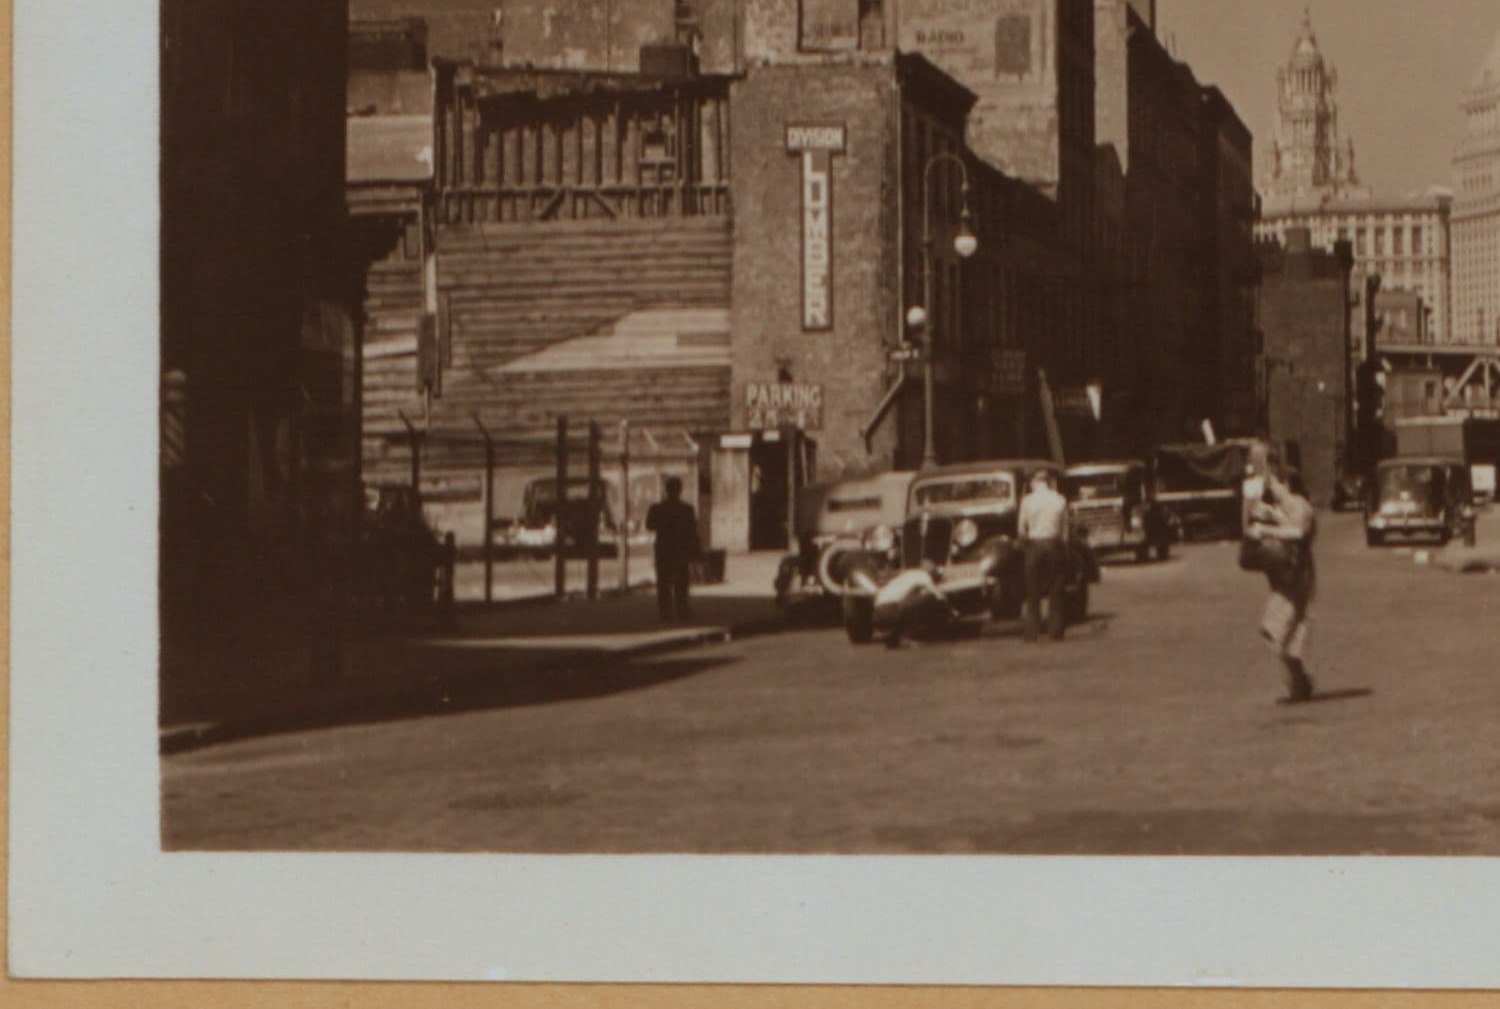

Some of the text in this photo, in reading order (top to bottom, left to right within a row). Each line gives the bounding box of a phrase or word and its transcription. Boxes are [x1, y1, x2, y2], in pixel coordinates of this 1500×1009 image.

[787, 127, 844, 150] DIVISION
[803, 151, 829, 328] LUMBER
[746, 382, 822, 408] PARKING
